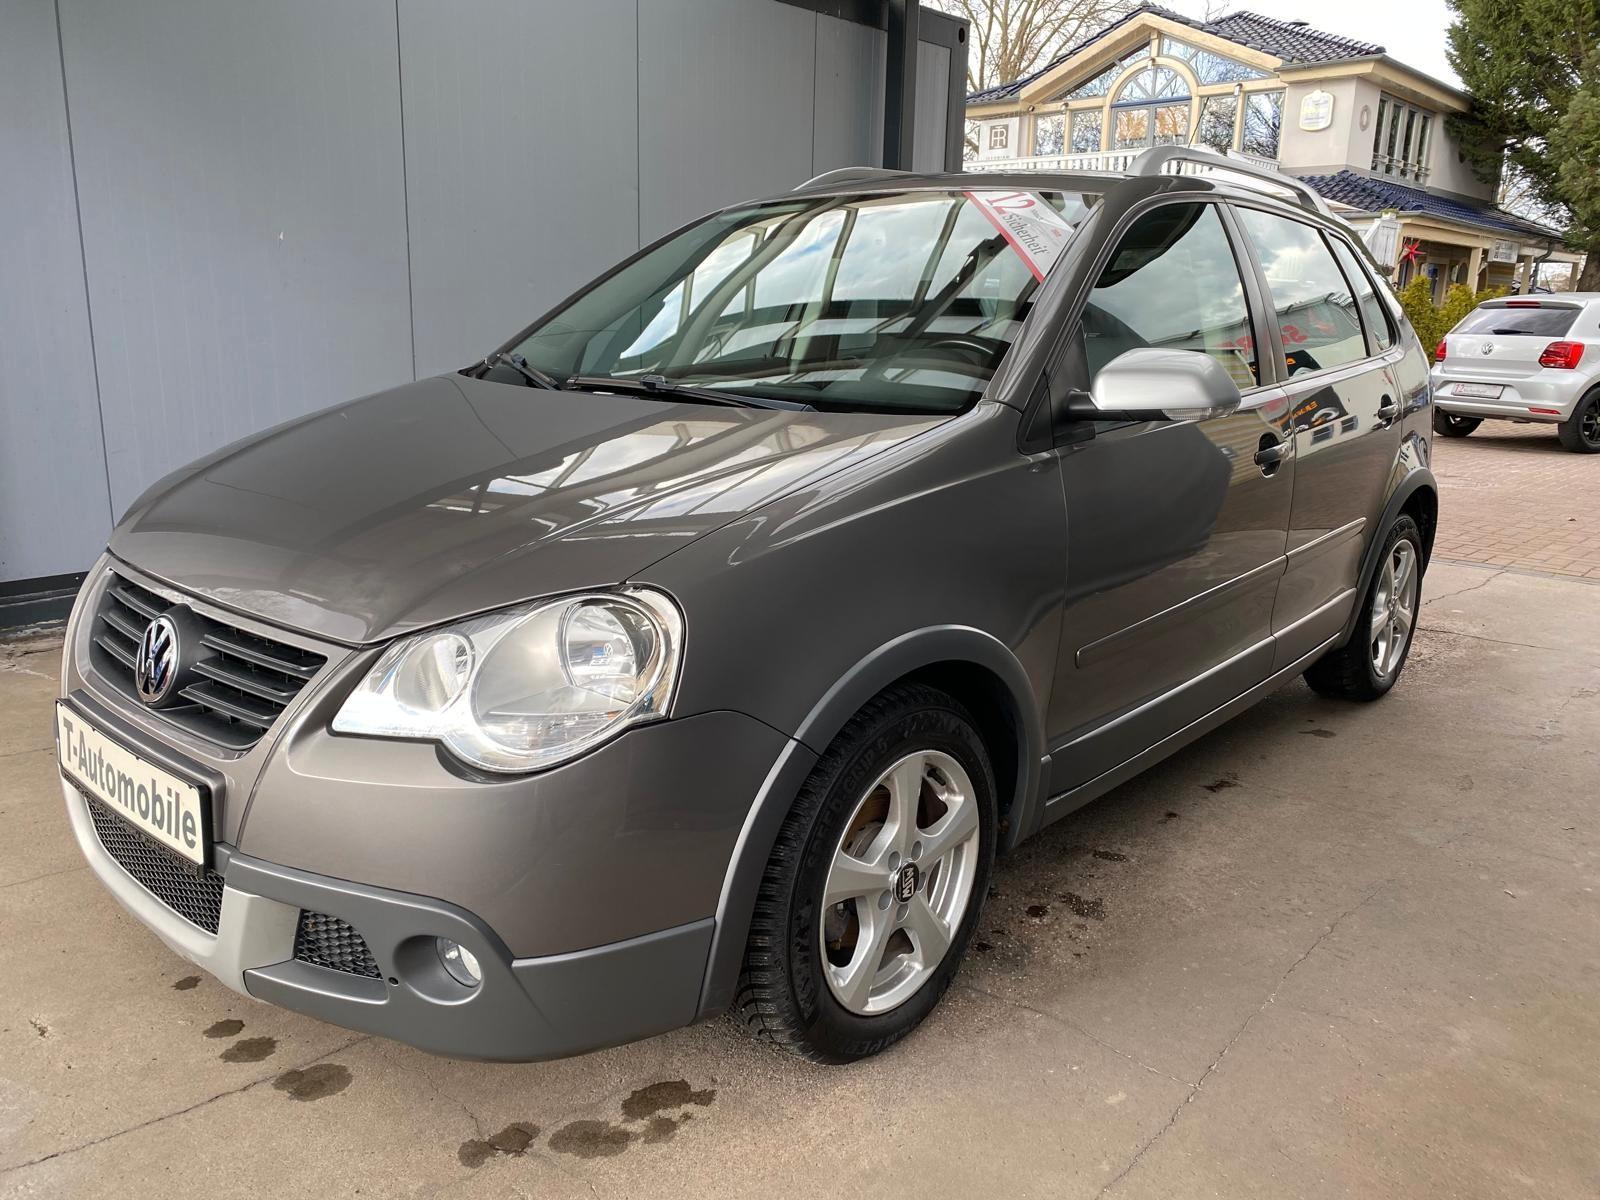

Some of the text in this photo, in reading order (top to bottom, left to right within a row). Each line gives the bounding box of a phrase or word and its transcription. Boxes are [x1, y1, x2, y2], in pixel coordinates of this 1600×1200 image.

[986, 191, 1036, 215] 12
[1002, 212, 1048, 255] Sicherheit
[61, 714, 198, 850] T-Automobile
